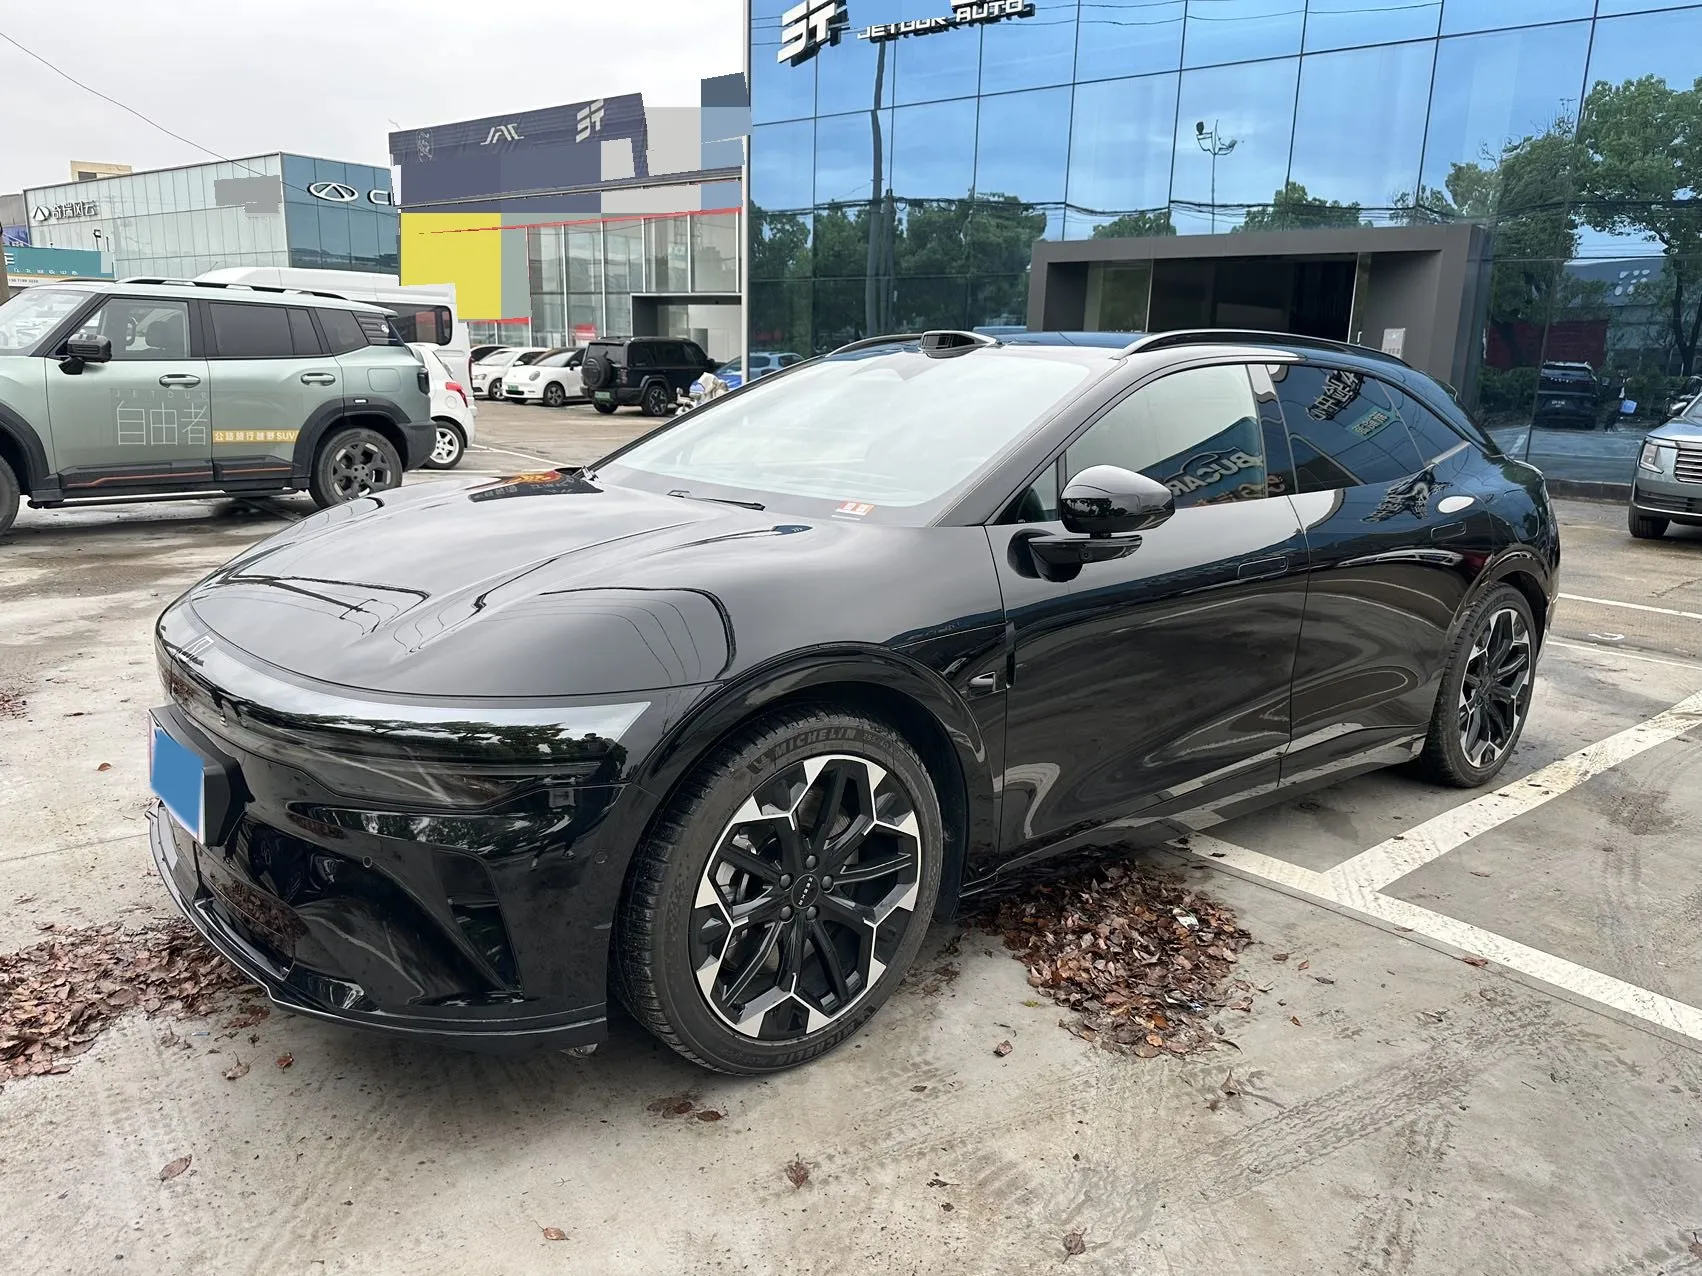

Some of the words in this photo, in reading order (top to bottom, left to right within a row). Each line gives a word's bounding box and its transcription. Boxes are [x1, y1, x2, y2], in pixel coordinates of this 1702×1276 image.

[956, 0, 1024, 23] AUTO
[480, 123, 525, 145] JAC
[116, 400, 209, 446] 自由者
[773, 727, 857, 759] MICHELIN
